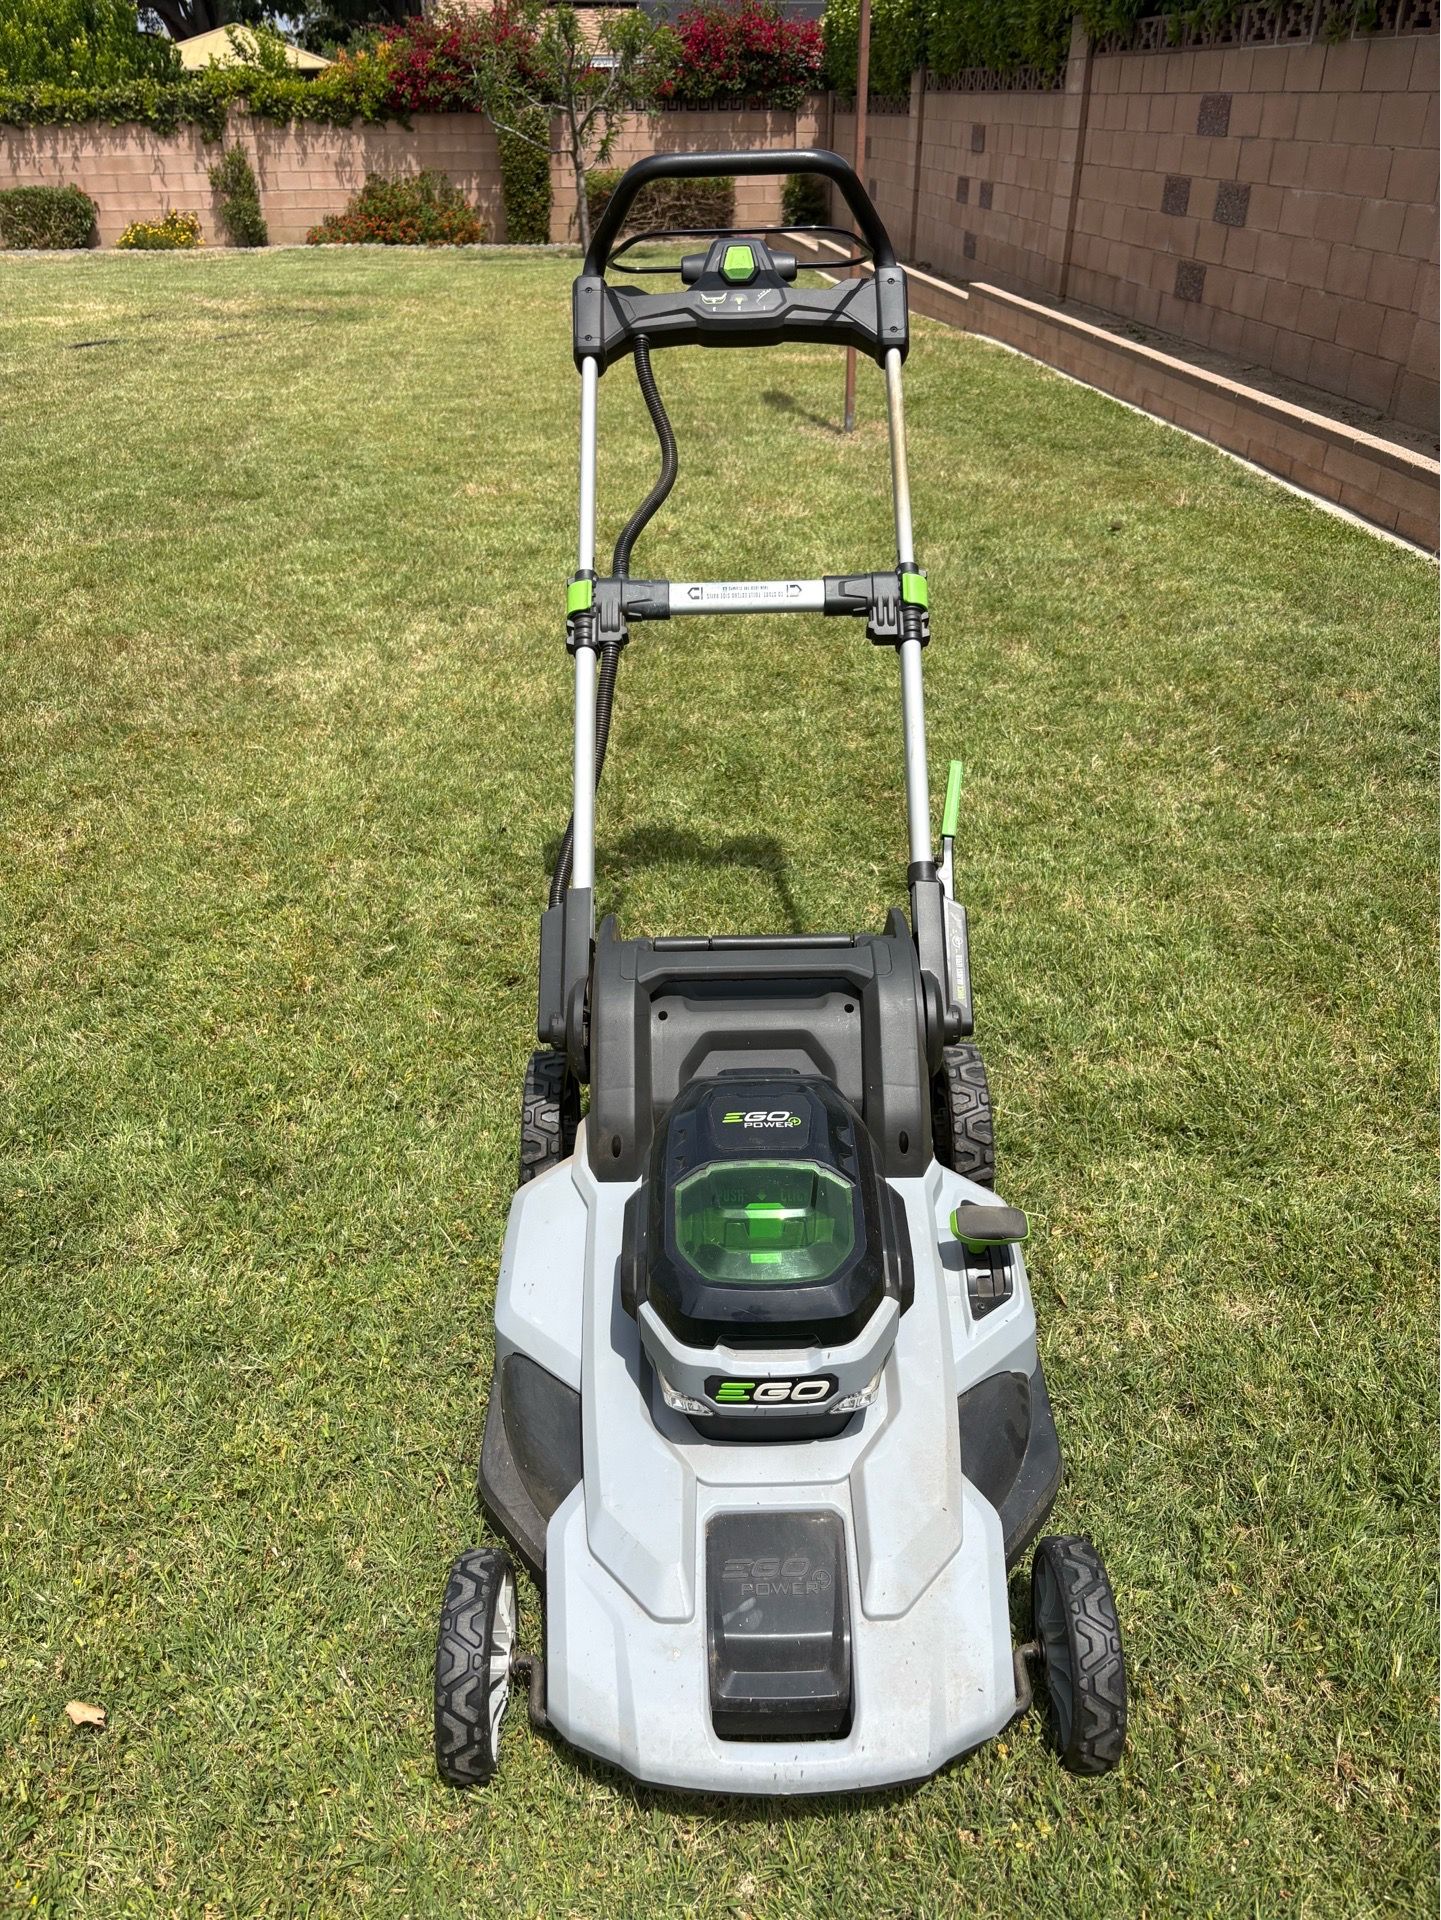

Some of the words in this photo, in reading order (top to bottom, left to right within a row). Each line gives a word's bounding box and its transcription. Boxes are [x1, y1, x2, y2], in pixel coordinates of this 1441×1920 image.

[722, 1111, 790, 1123] EGO
[716, 1380, 830, 1401] EGO
[721, 1557, 811, 1579] EGO
